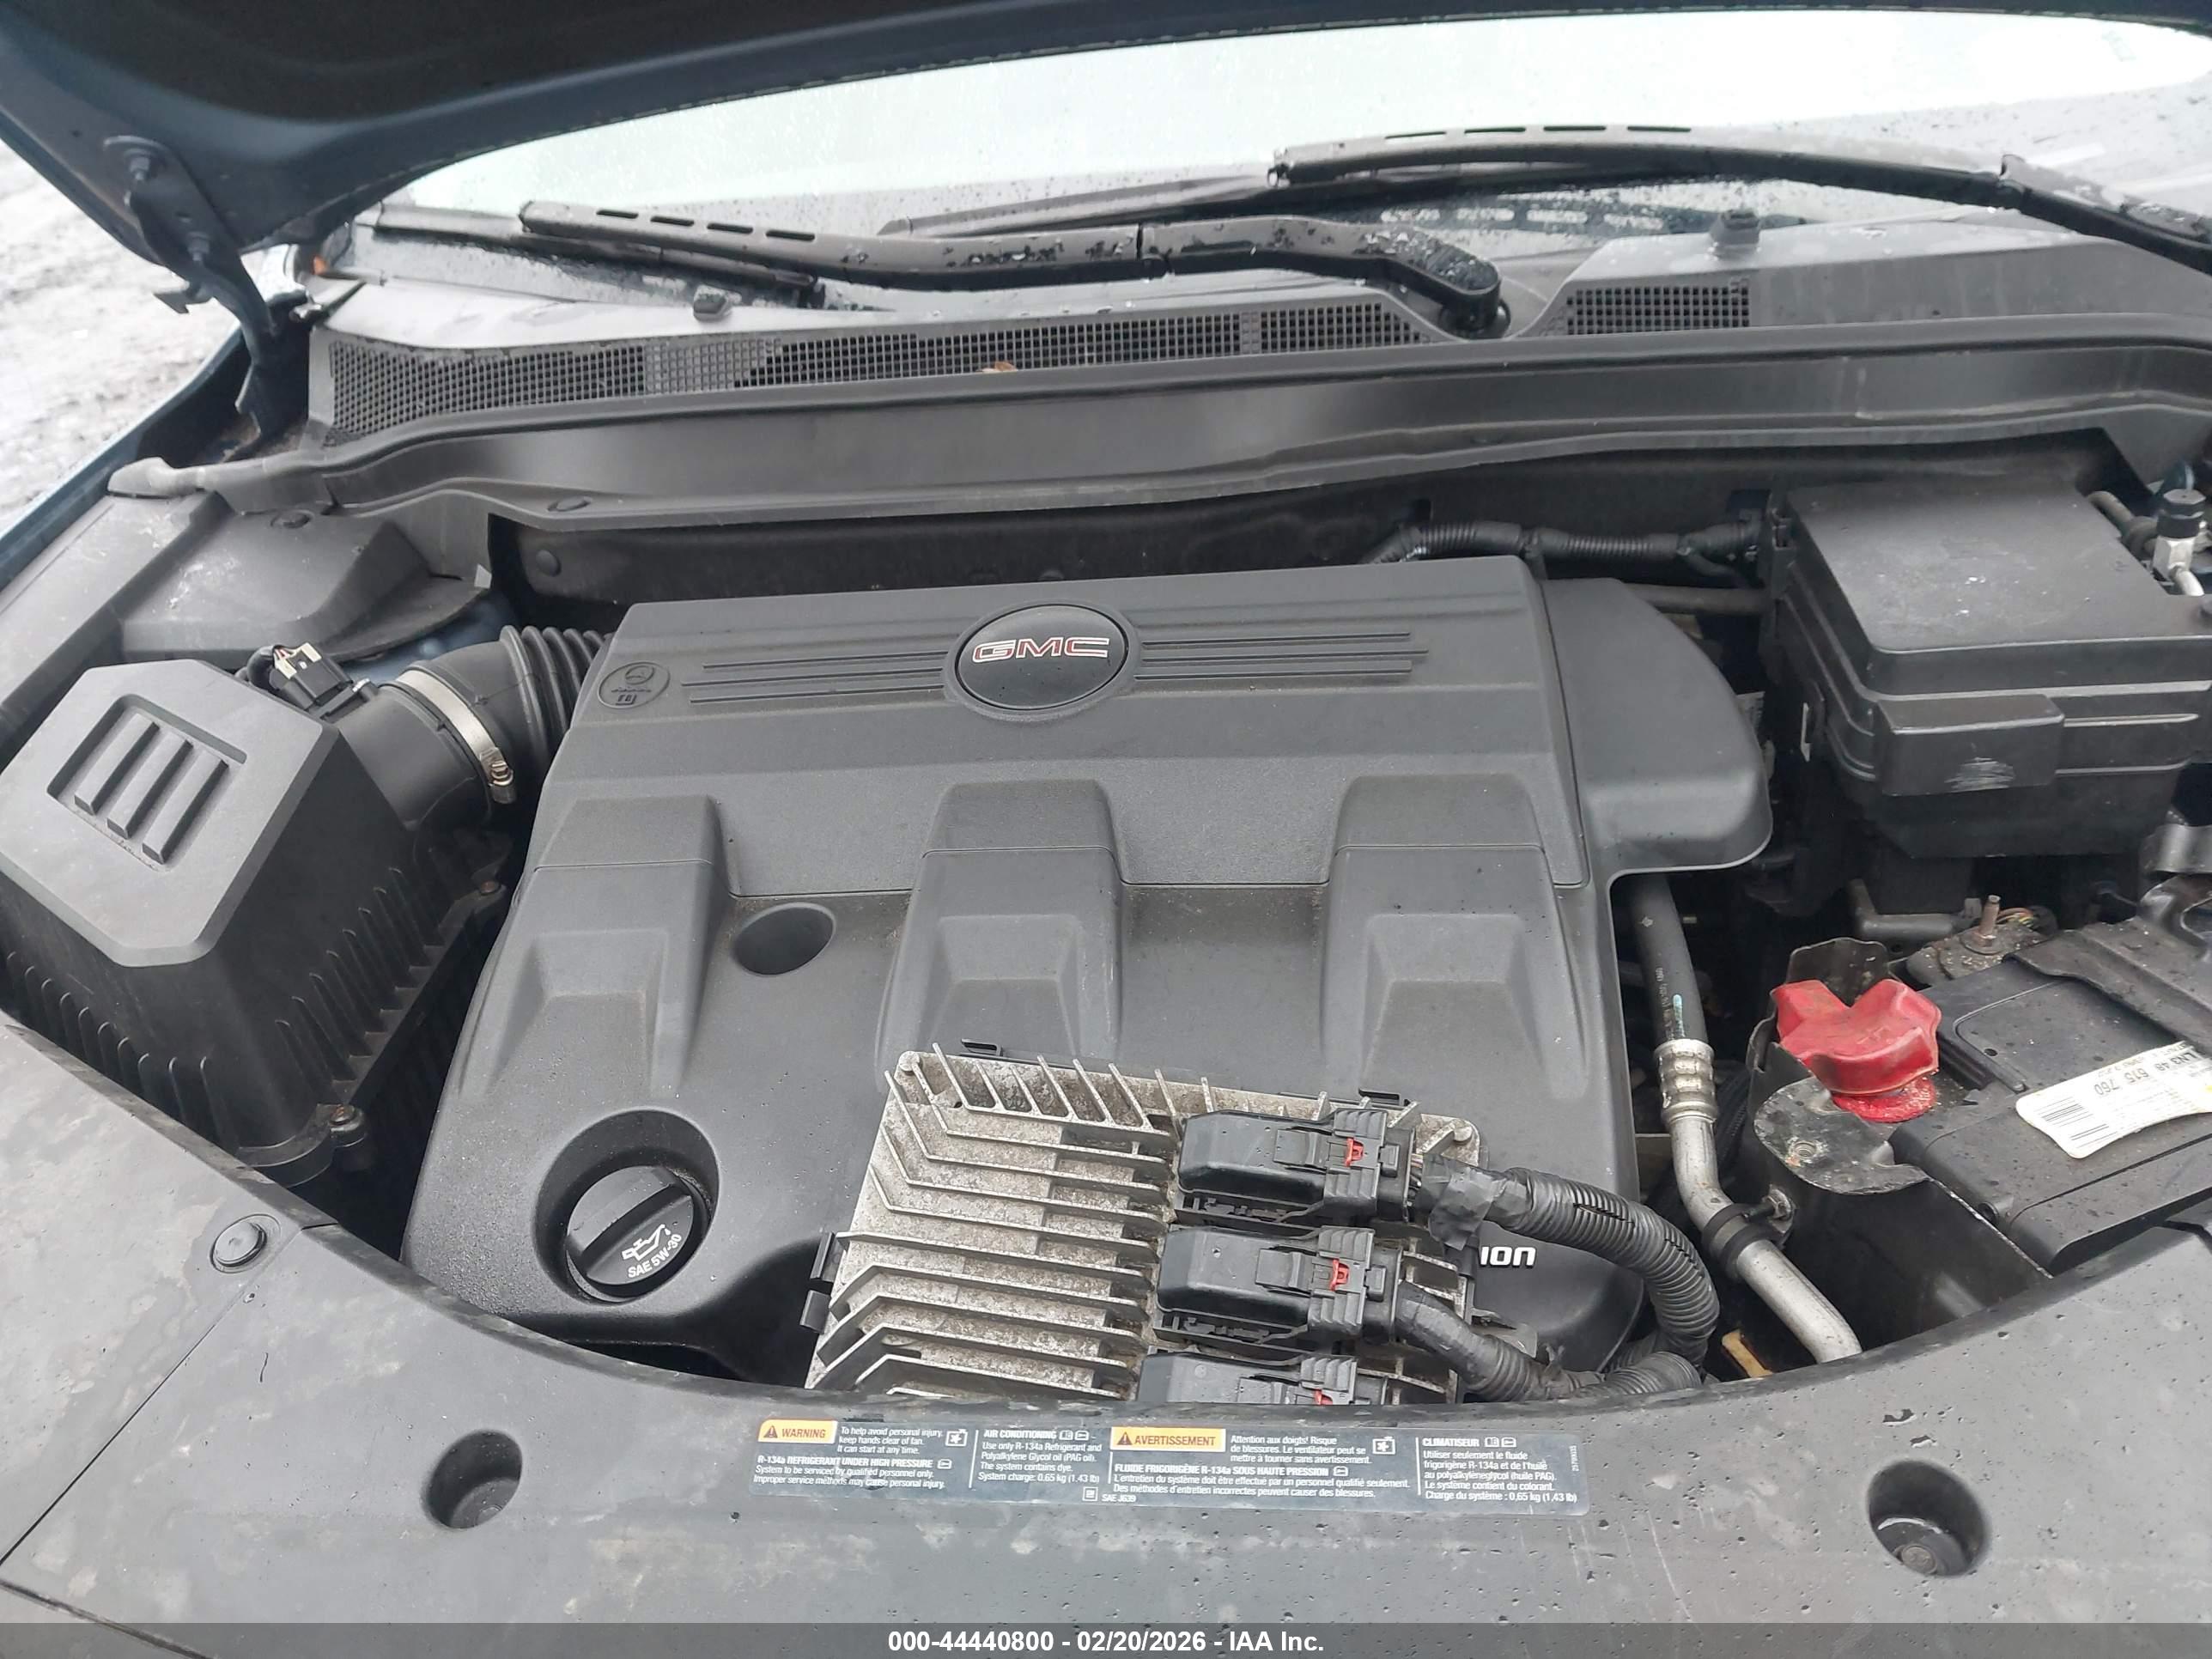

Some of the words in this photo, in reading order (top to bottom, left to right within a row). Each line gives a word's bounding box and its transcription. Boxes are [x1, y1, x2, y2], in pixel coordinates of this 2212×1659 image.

[972, 636, 1109, 663] GMC
[2124, 1068, 2149, 1084] 615
[2094, 1079, 2120, 1096] 760
[628, 1261, 653, 1278] SAE
[652, 1233, 683, 1267] 5W-30
[781, 1428, 826, 1438] WARNING
[983, 1429, 999, 1438] AIR
[1000, 1430, 1056, 1439] CONDITIONING
[1134, 1436, 1216, 1446] AVERTISSEMENT
[1422, 1437, 1480, 1447] CLIMATISEUR
[757, 1455, 786, 1464] R-134a
[787, 1456, 841, 1465] REFRIGERANT
[842, 1457, 869, 1467] UNDER
[870, 1458, 890, 1467] HIGH
[890, 1459, 933, 1468] PRESSURE
[1115, 1463, 1144, 1473] FLUIDE
[1145, 1463, 1200, 1474] FRIGORIGÈNE
[1200, 1466, 1231, 1474] R-134a
[1232, 1467, 1255, 1475] SOUS
[1257, 1467, 1285, 1476] HAUTE
[1286, 1468, 1328, 1476] PRESSION
